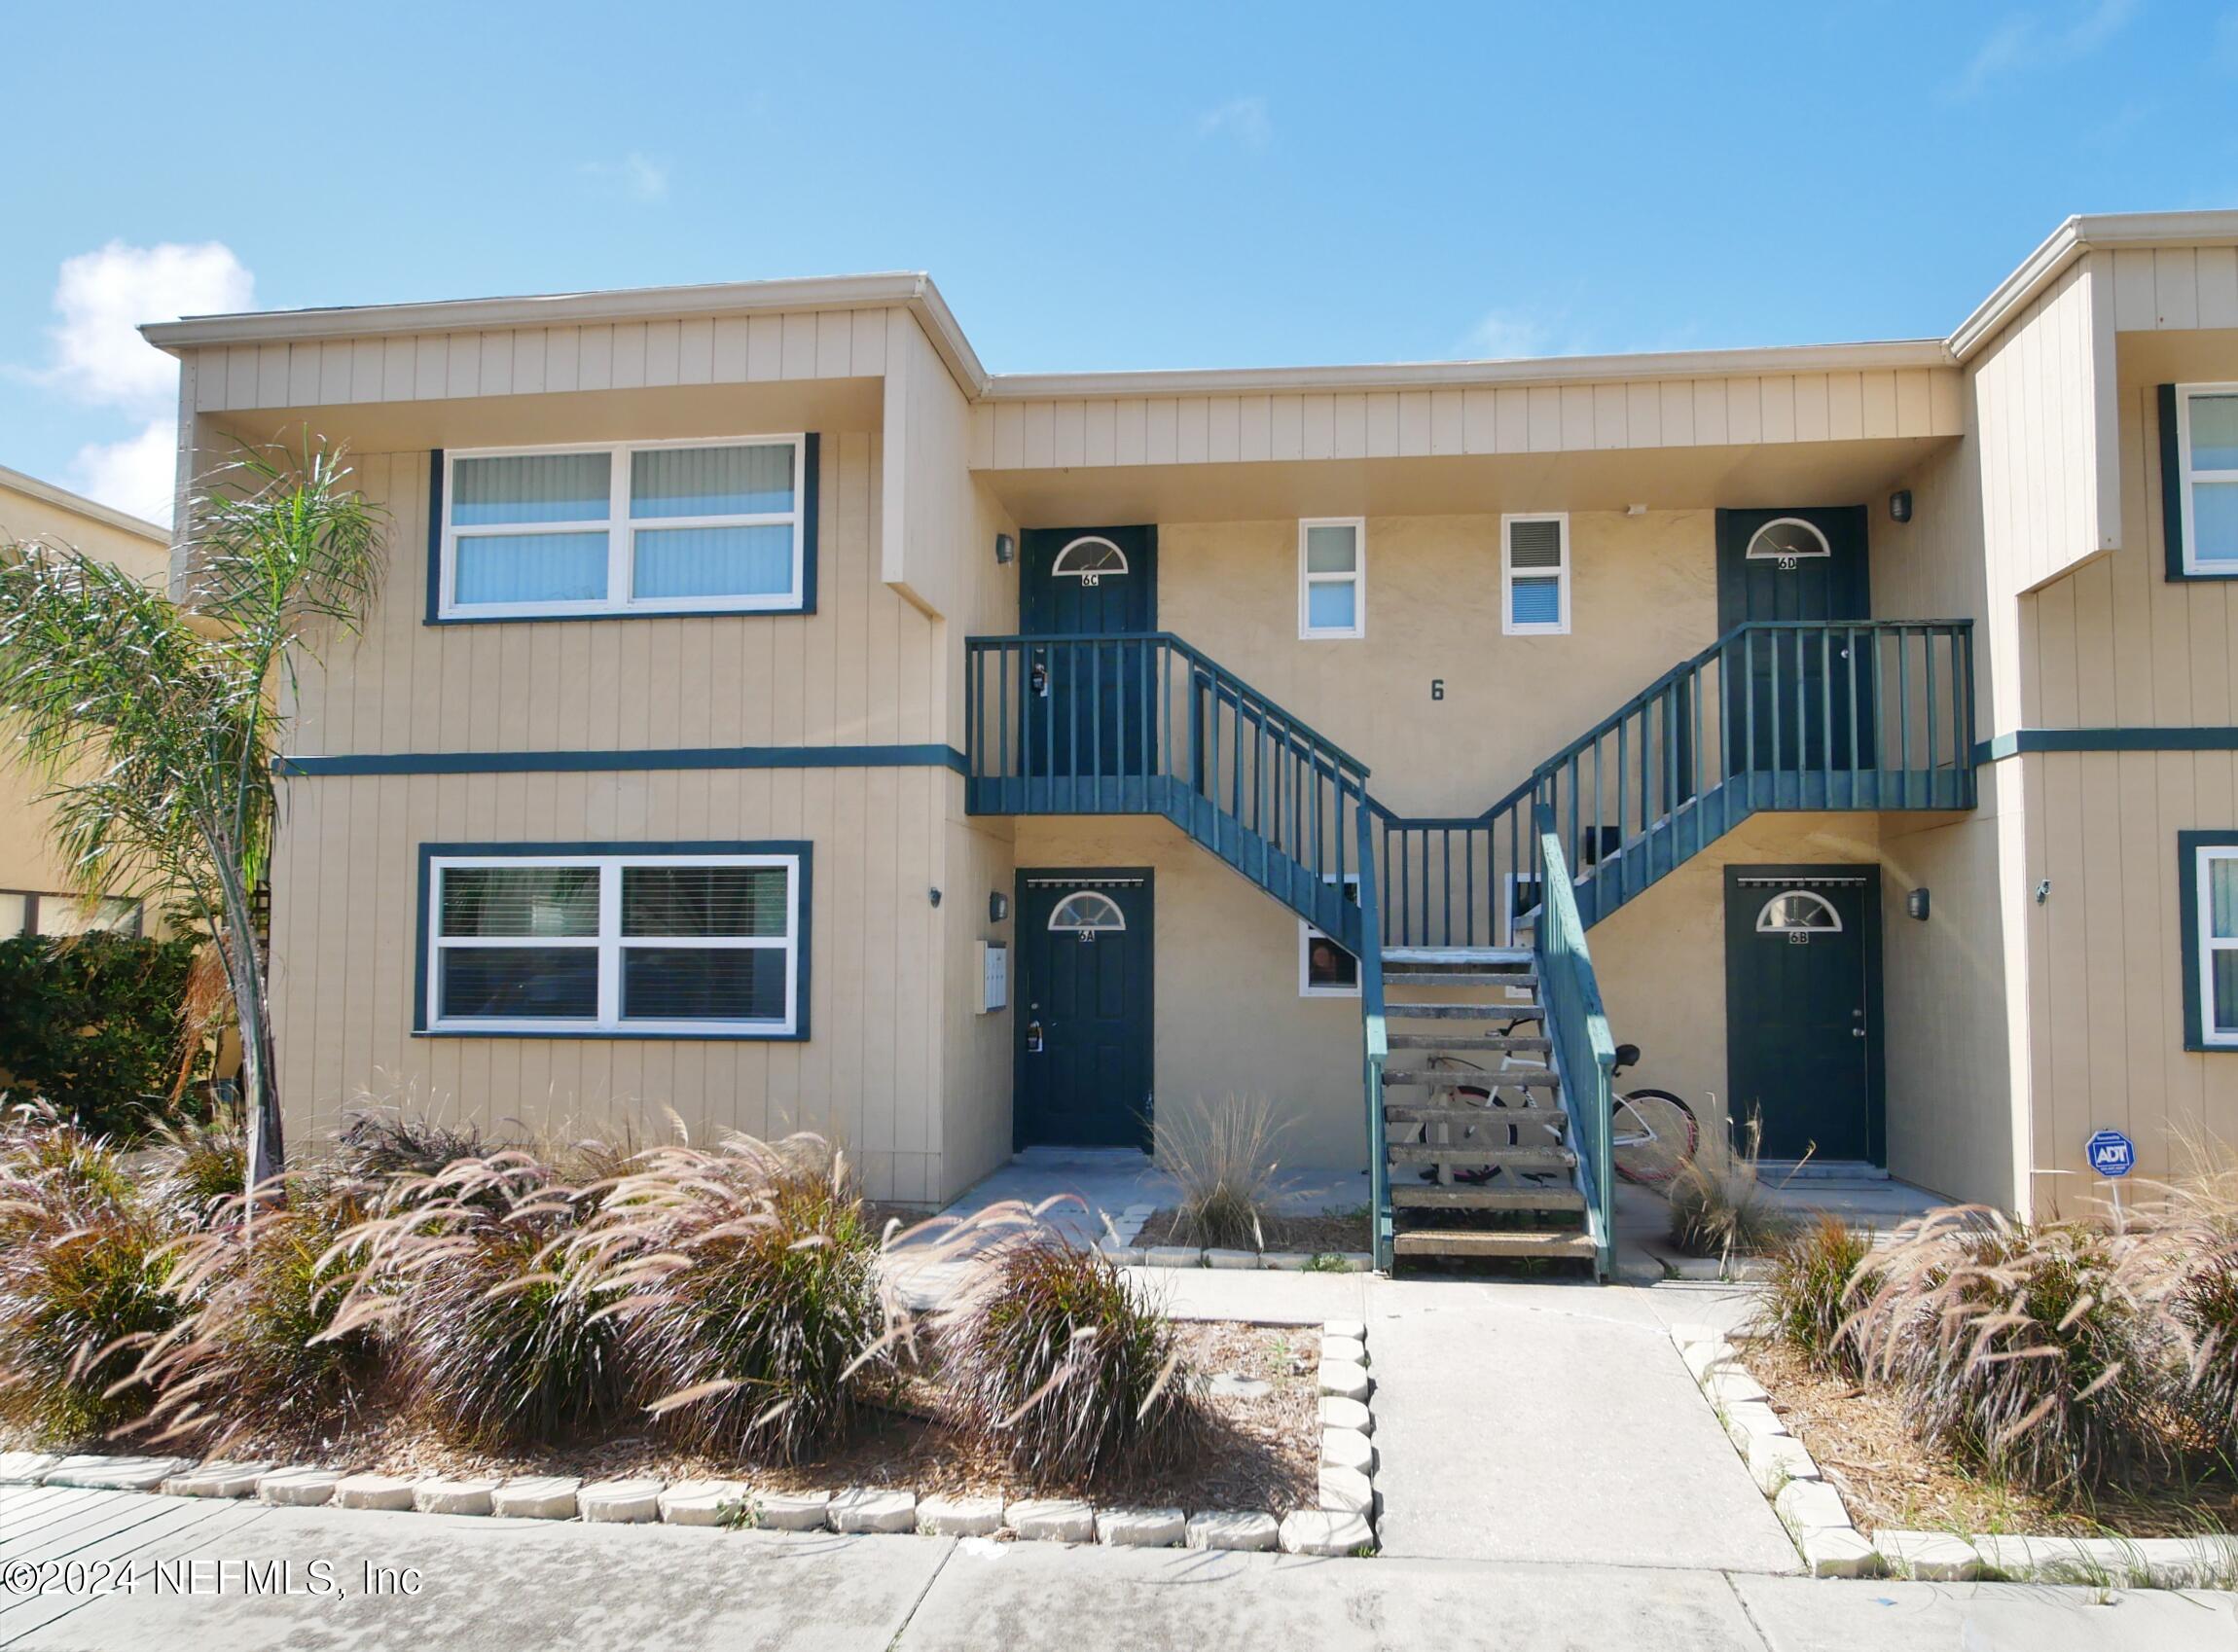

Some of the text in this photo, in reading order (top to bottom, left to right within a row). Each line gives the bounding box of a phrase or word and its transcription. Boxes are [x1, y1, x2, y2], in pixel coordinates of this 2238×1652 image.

[1780, 557, 1795, 569] 6D
[1083, 574, 1098, 586] 6C
[1431, 679, 1444, 700] 6
[1079, 929, 1094, 942] 6A
[1790, 931, 1807, 943] 6B
[2097, 1145, 2127, 1164] ADT
